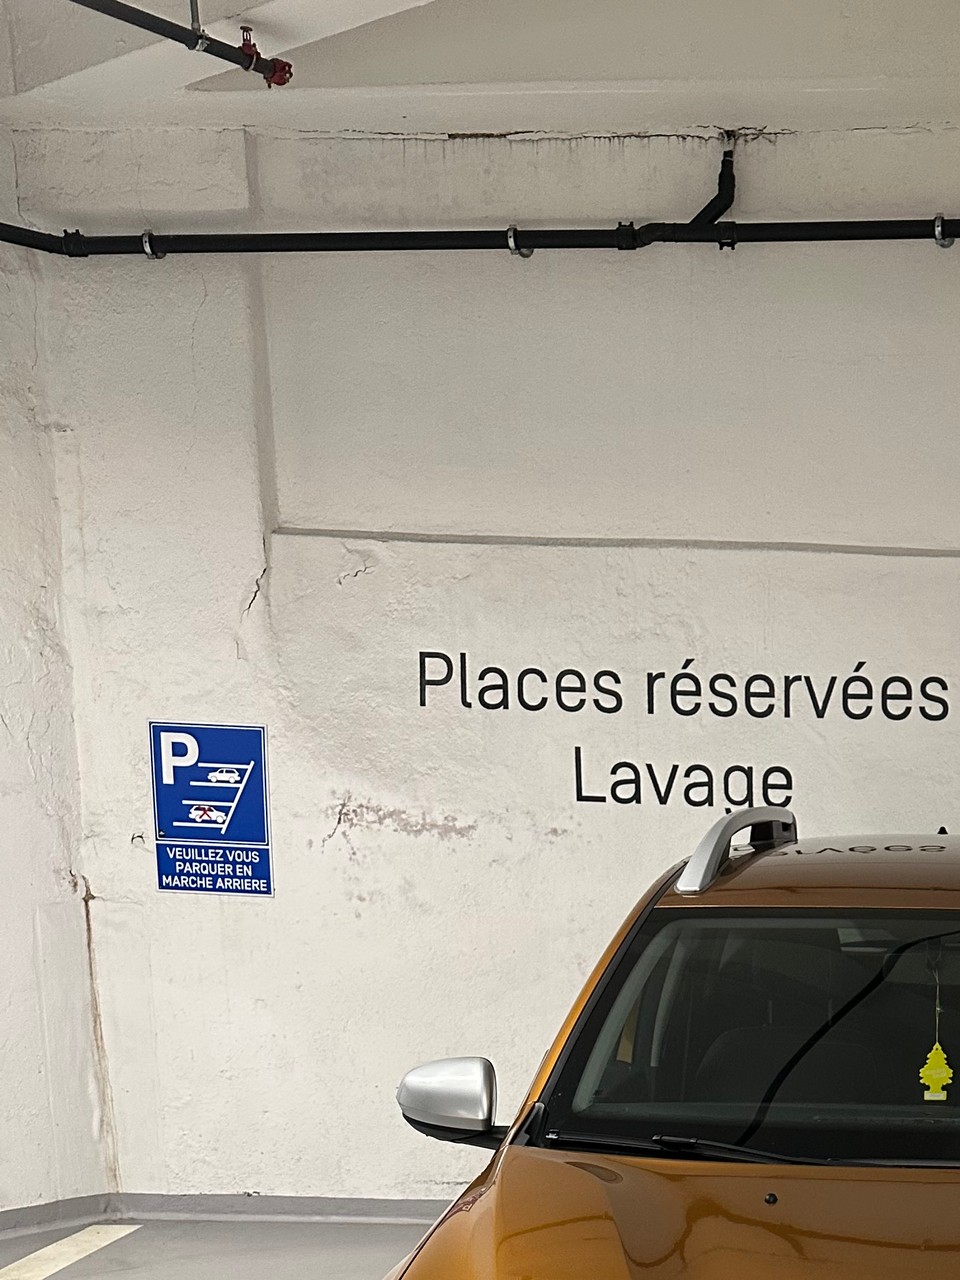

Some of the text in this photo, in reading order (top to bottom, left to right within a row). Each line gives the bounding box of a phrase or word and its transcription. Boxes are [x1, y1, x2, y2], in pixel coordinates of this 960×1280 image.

[418, 651, 950, 721] Places réservées
[160, 731, 199, 784] P
[574, 746, 794, 814] Lavage
[166, 847, 260, 863] VEUILLEZ VOUS
[175, 862, 253, 877] PARQUER EN
[162, 875, 268, 891] MARCHE ARRIERE
